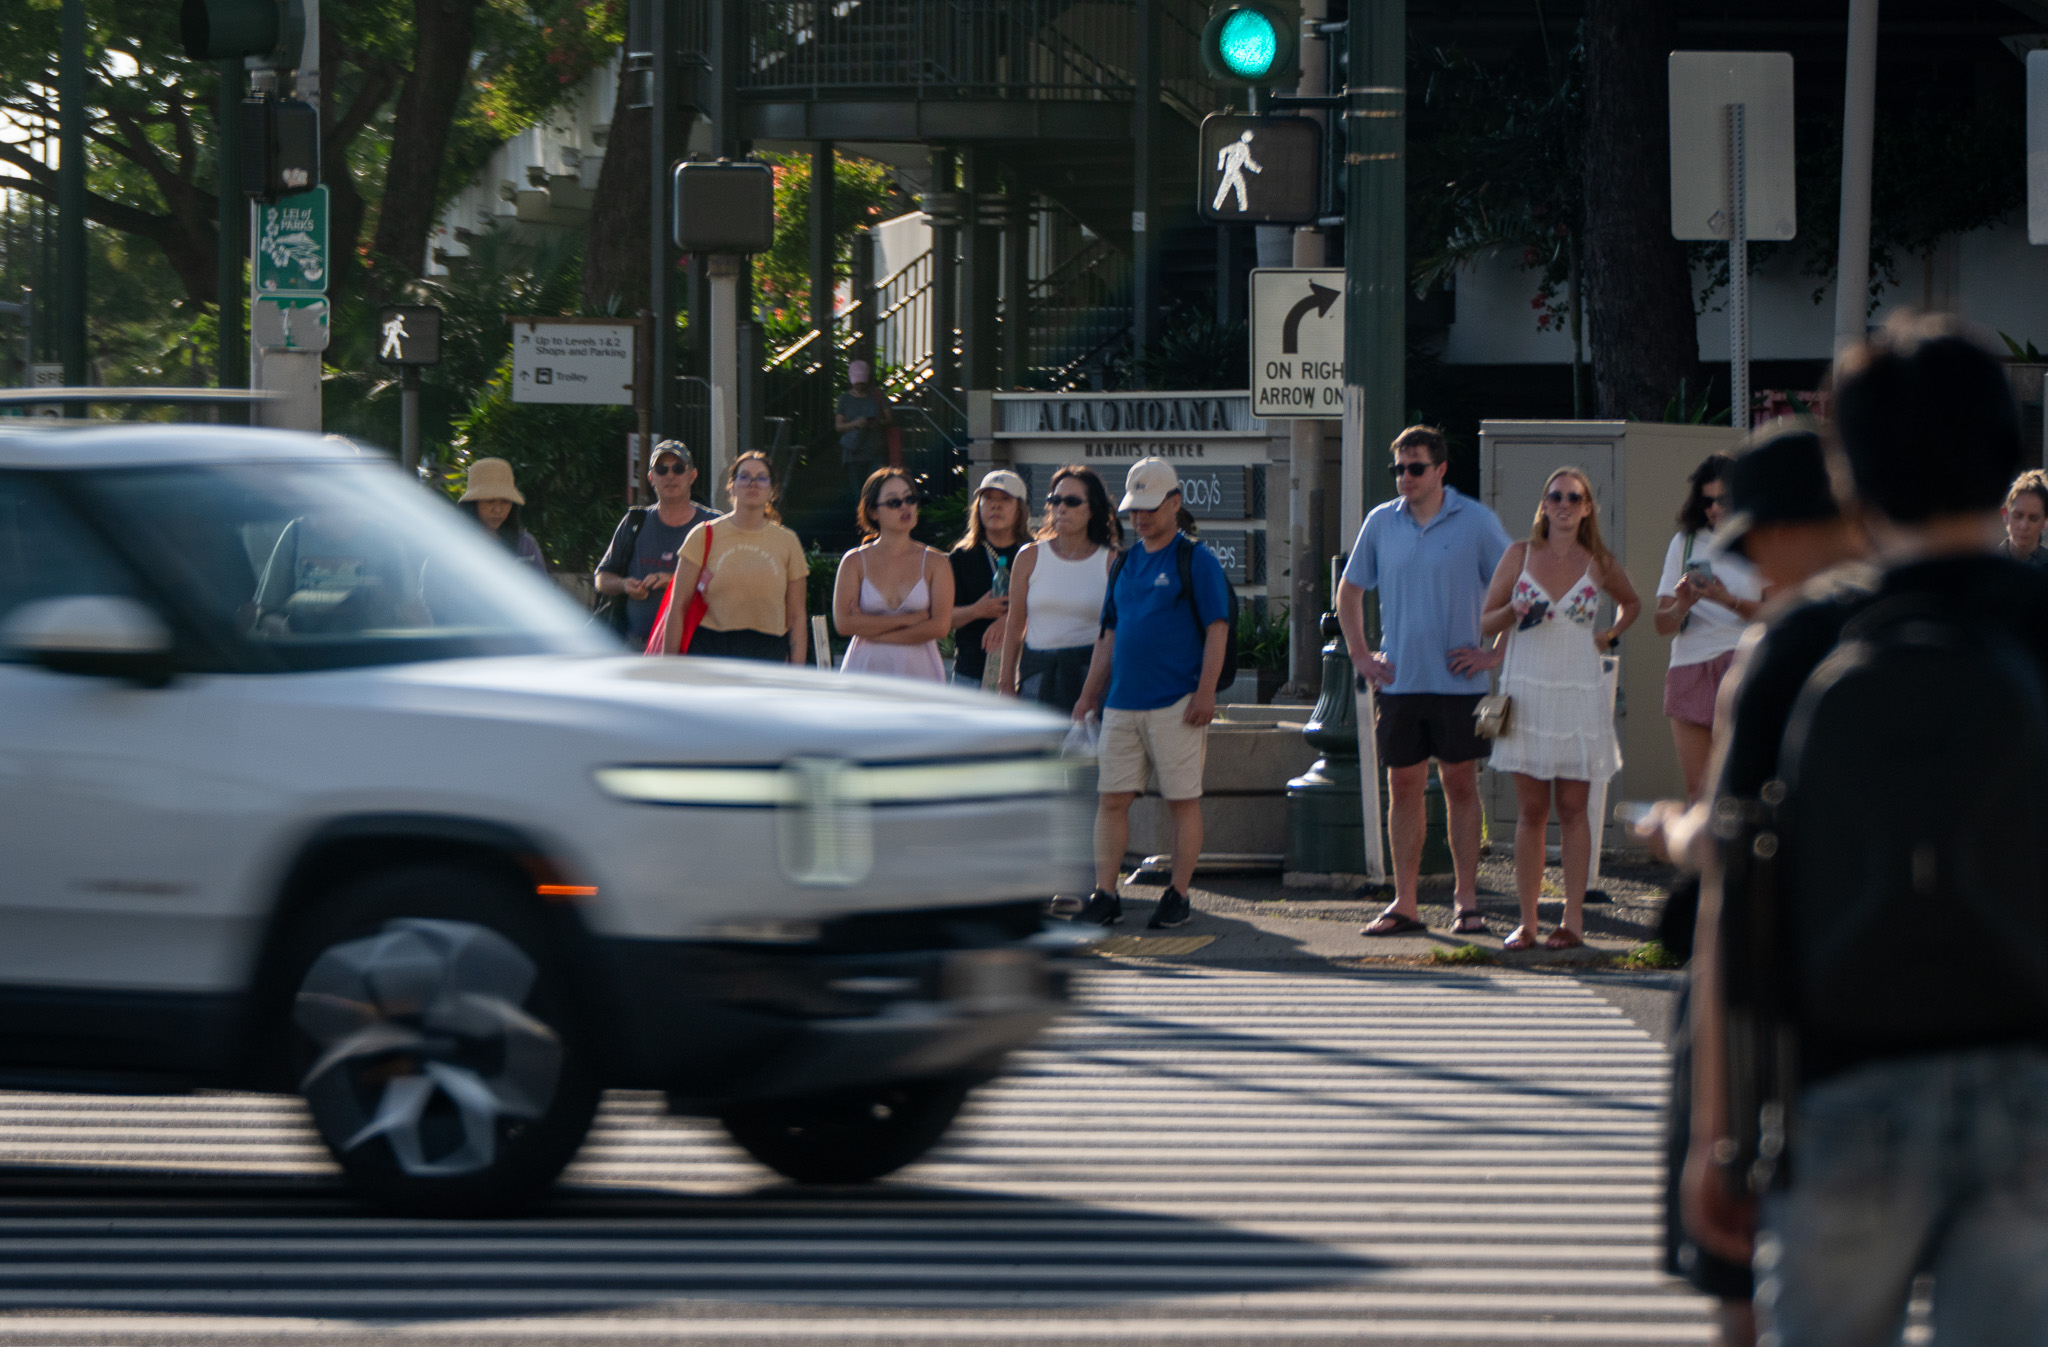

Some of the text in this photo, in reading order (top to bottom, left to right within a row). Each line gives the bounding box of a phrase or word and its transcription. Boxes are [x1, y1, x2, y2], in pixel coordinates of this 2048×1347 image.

[282, 207, 313, 220] LEI of
[280, 219, 315, 231] PARKS
[535, 336, 550, 347] Up
[552, 337, 563, 346] to
[565, 337, 597, 347] Levels
[536, 346, 627, 359] Shops and Parking
[556, 371, 589, 383] Trolley
[1266, 361, 1344, 380] ON RIGH
[37, 372, 64, 384] SPE
[1259, 386, 1344, 406] ARROW ON
[1085, 442, 1205, 458] HAWAII'S CENTER
